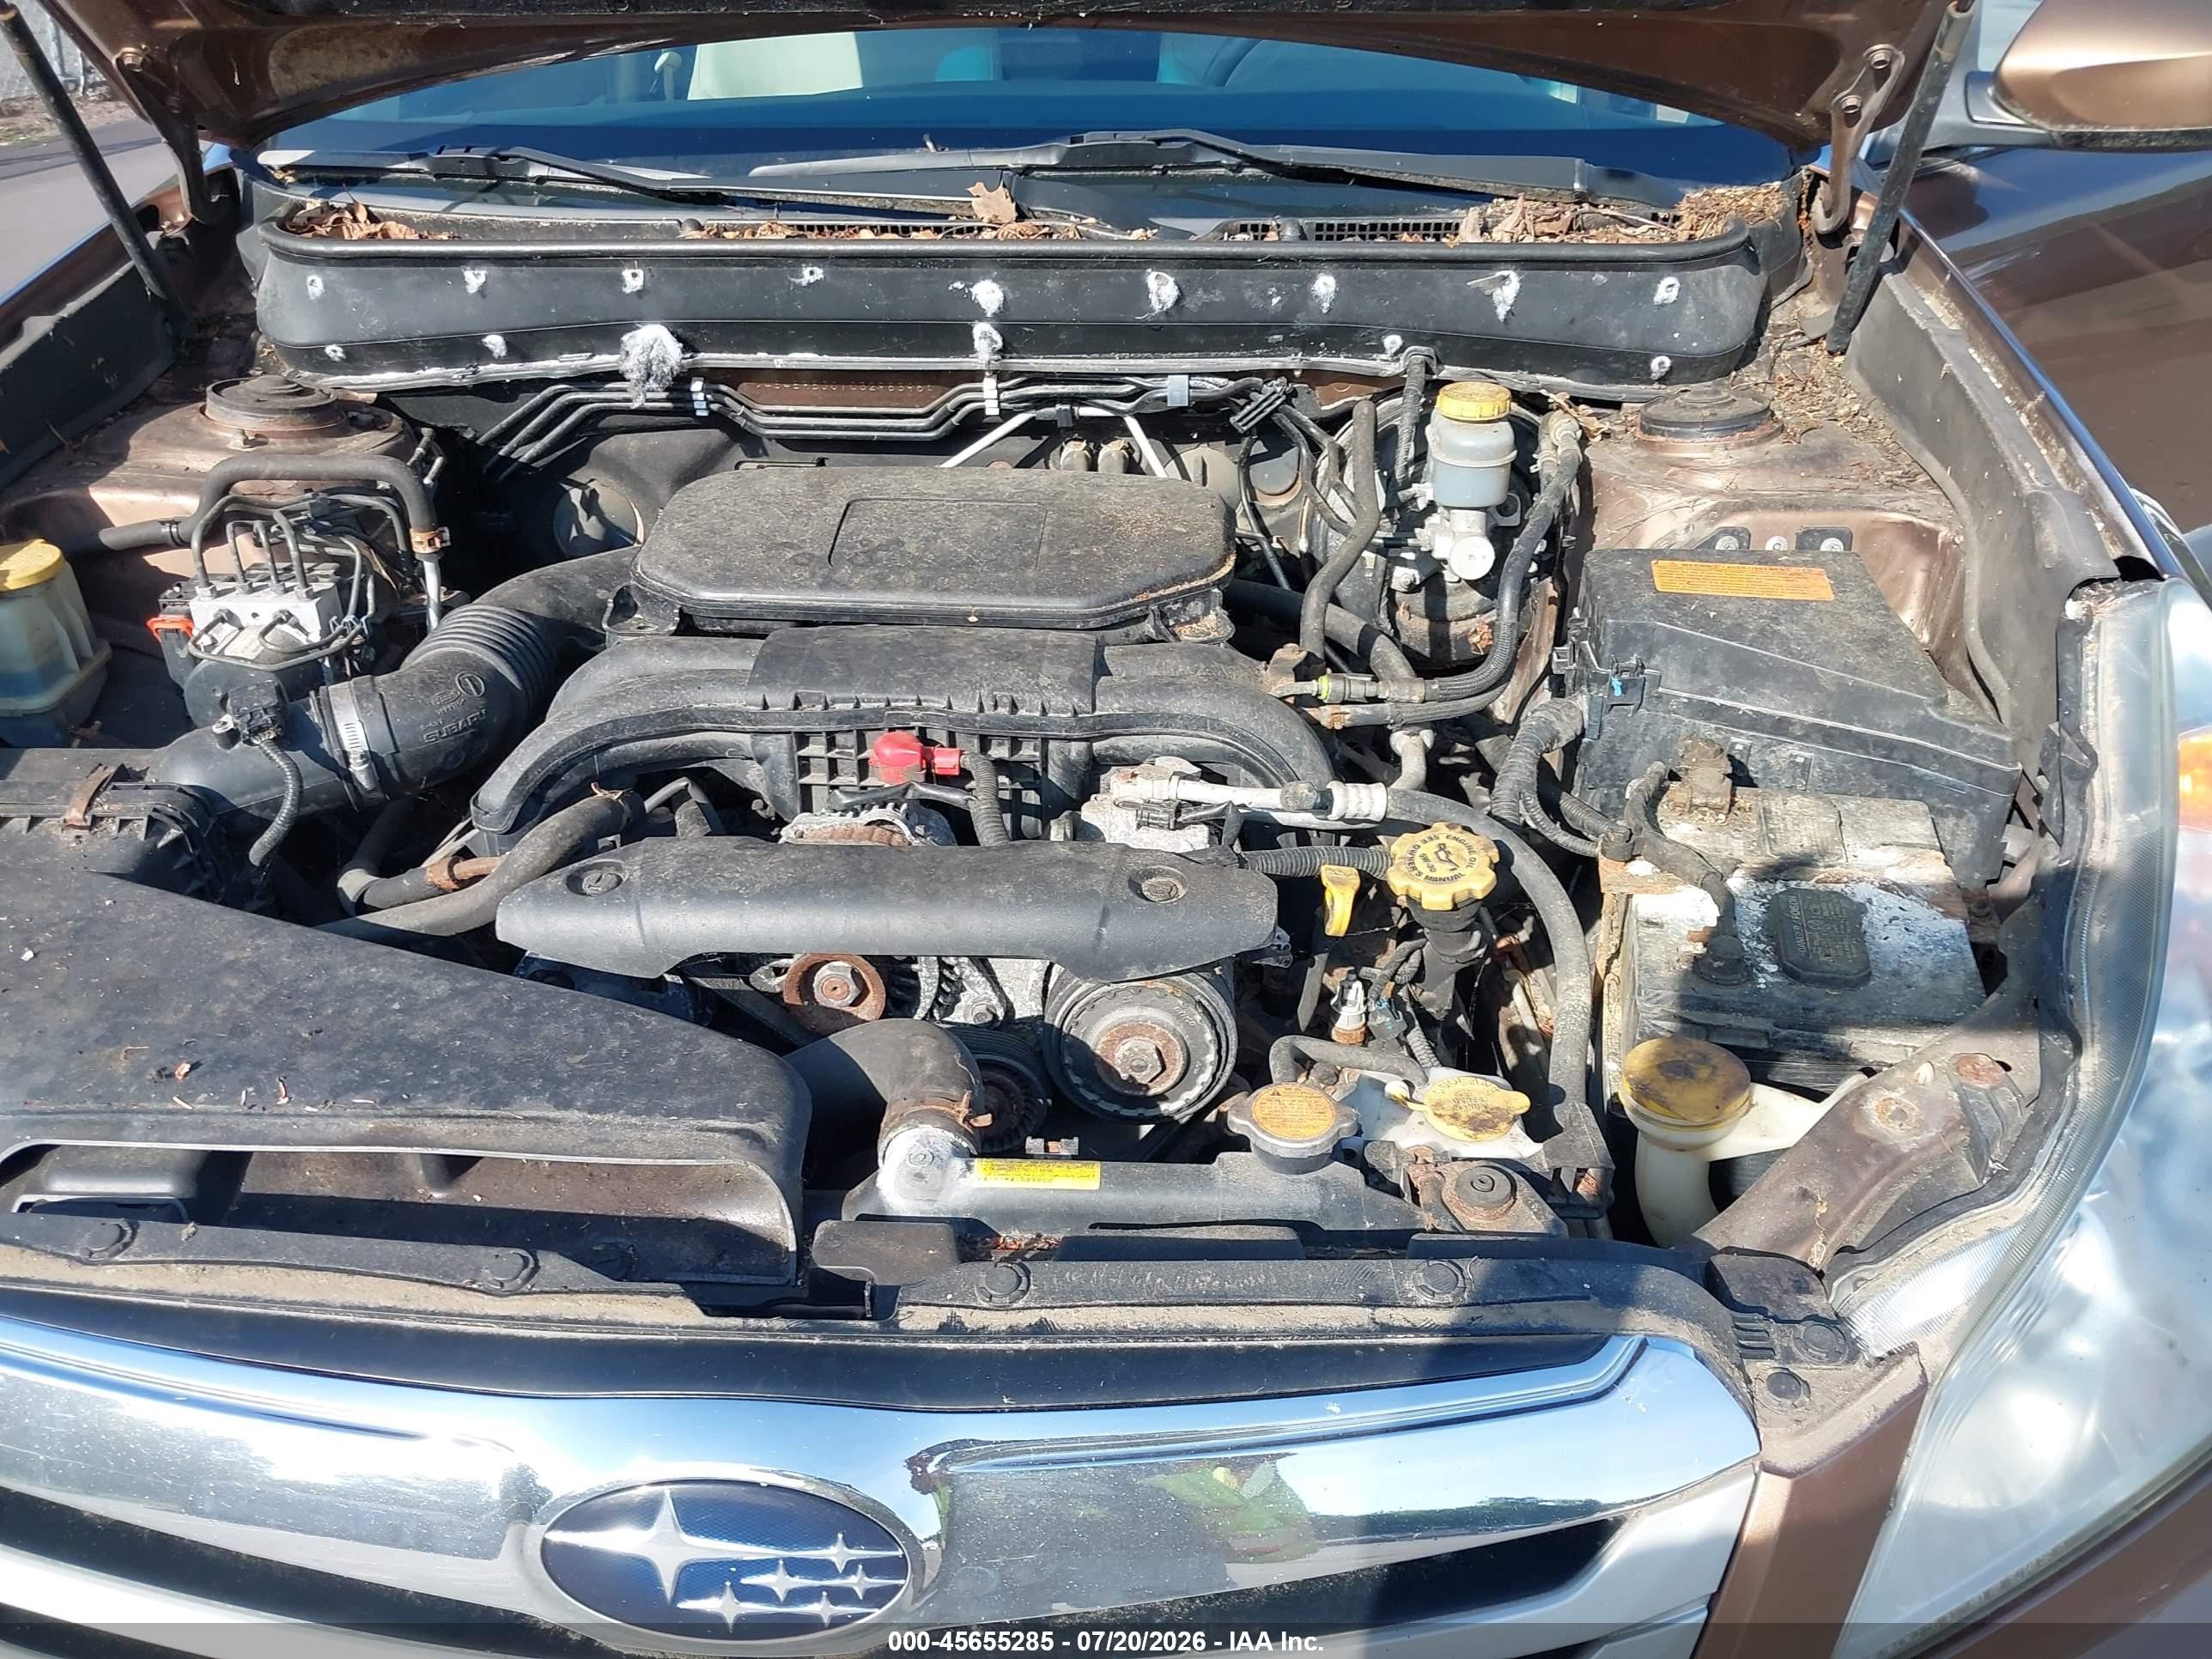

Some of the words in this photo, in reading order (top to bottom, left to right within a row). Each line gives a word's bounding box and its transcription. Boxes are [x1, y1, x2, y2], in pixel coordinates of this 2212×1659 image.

[1419, 834, 1440, 846] SEE
[1446, 834, 1476, 855] ENGINE
[1465, 857, 1477, 868] OIL
[1424, 872, 1466, 883] MANUAL
